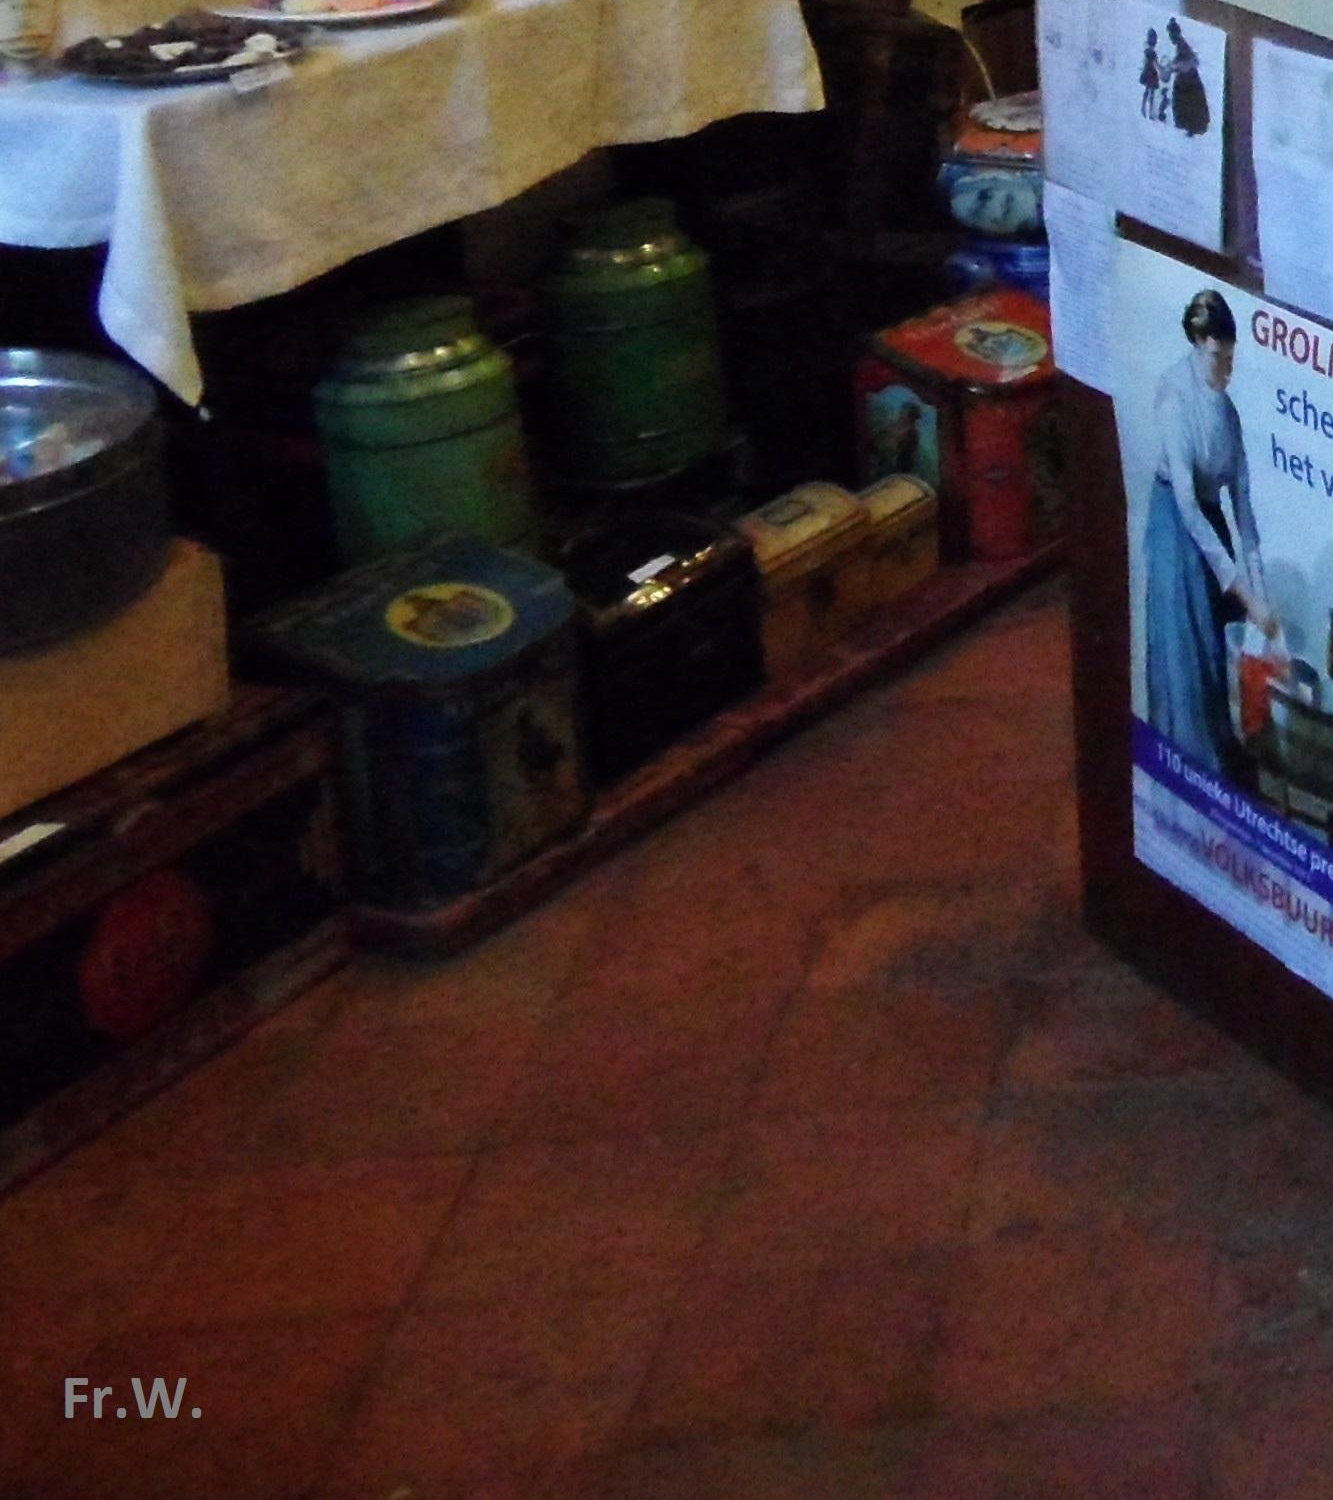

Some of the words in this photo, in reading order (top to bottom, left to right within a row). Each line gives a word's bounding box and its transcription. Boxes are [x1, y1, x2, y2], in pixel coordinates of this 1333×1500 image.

[1271, 433, 1314, 488] het
[1156, 741, 1182, 775] 110
[1184, 763, 1231, 805] unieke
[1233, 795, 1308, 861] Utrechtse
